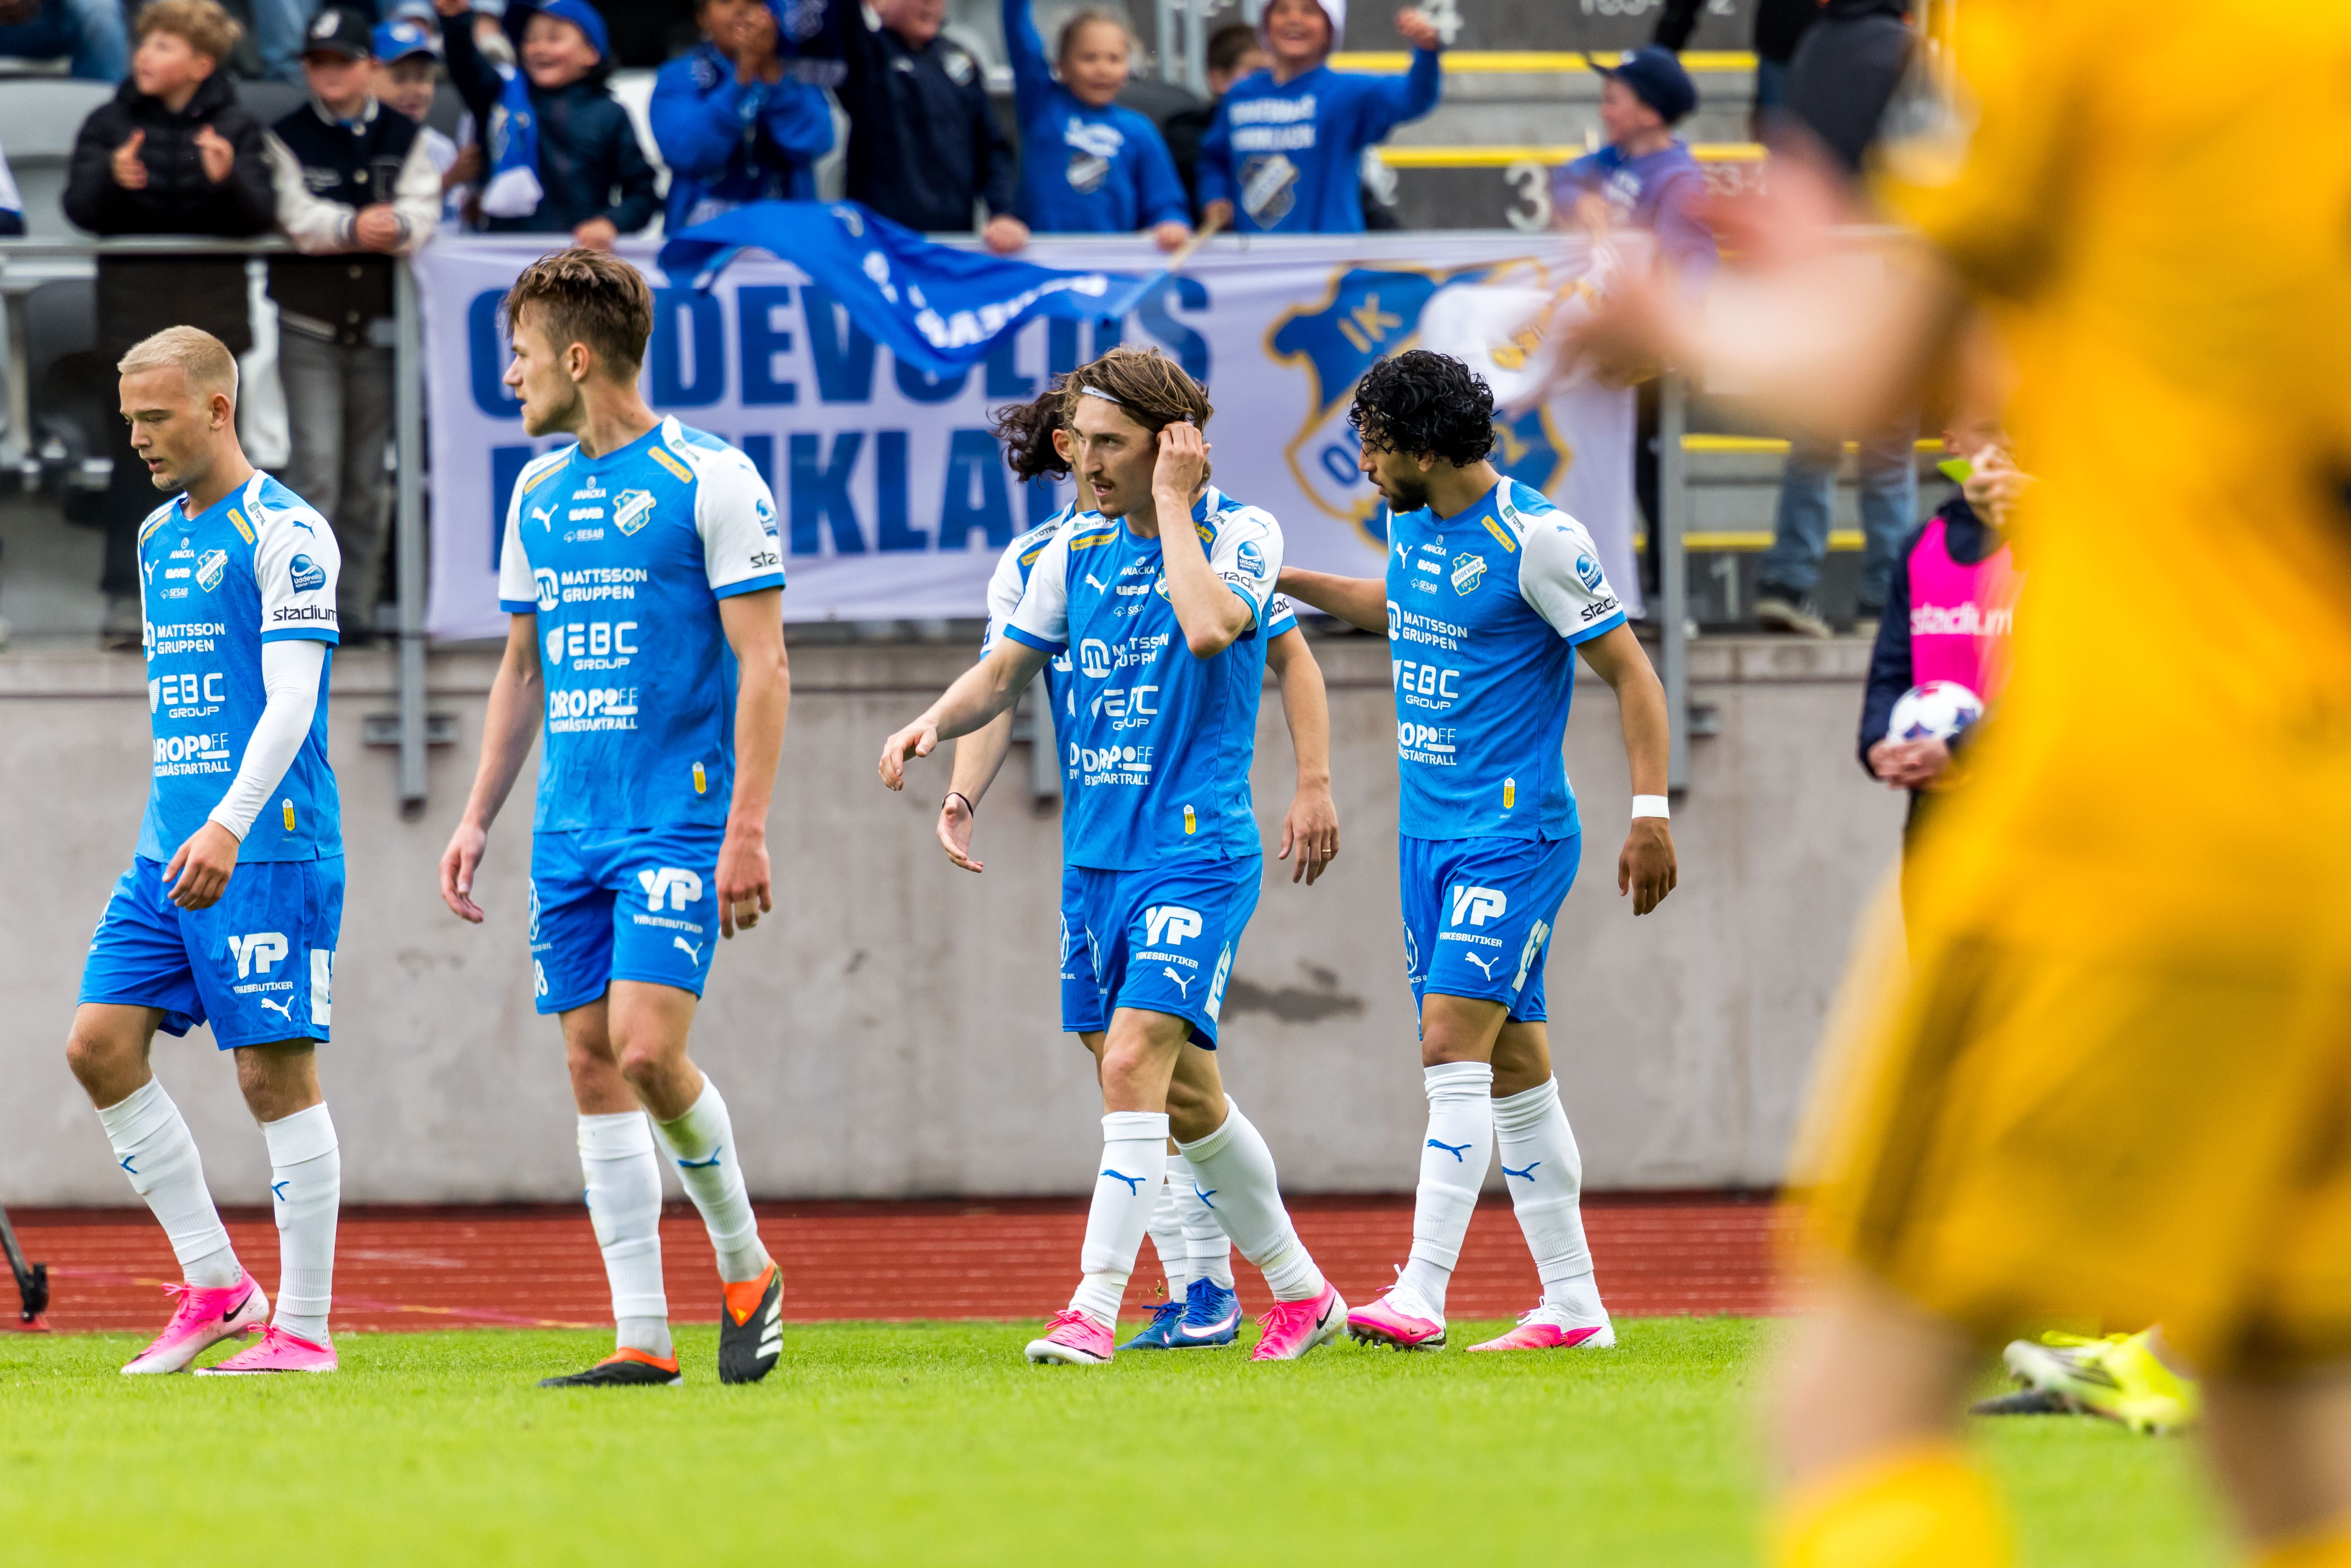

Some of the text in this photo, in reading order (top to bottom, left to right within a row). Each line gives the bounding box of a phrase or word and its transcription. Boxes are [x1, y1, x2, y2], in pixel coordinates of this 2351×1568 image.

[1504, 163, 1554, 231] 3
[1337, 292, 1404, 354] IK
[572, 488, 606, 500] ANACKA
[1511, 515, 1525, 533] TOTAL
[576, 528, 604, 539] SESAB
[170, 550, 194, 559] ANACKA
[1421, 543, 1446, 556] ANACKA
[200, 554, 223, 580] ODDEVOLD
[1120, 565, 1155, 576] ANACKA
[1417, 559, 1441, 575] UFAB
[1454, 561, 1480, 582] ODDEVOLD
[561, 568, 648, 585] MATTSSON
[1461, 576, 1475, 589] 1932
[169, 587, 188, 597] SESAB
[562, 585, 635, 603] GRUPPEN
[1419, 580, 1437, 592] SESAB
[1404, 610, 1468, 638] MATTSSON
[1910, 600, 2013, 636] stadium
[157, 623, 225, 638] MATTSSON
[567, 621, 639, 657] EBC
[1402, 627, 1457, 651] GRUPPEN
[157, 639, 214, 655] GRUPPEN
[573, 657, 630, 671] GROUP
[1403, 660, 1460, 699] EBC
[162, 672, 226, 705] EBC
[1405, 694, 1451, 710] GROUP
[169, 706, 220, 719] GROUP
[637, 867, 703, 912] YP
[1451, 885, 1507, 927] YP
[1146, 905, 1202, 947] YP
[1439, 932, 1503, 948] YRKESBUTIKER
[228, 932, 288, 980] YP
[1136, 951, 1199, 969] YRKESBUTIKER
[233, 981, 293, 994] YRKESBUTIKER
